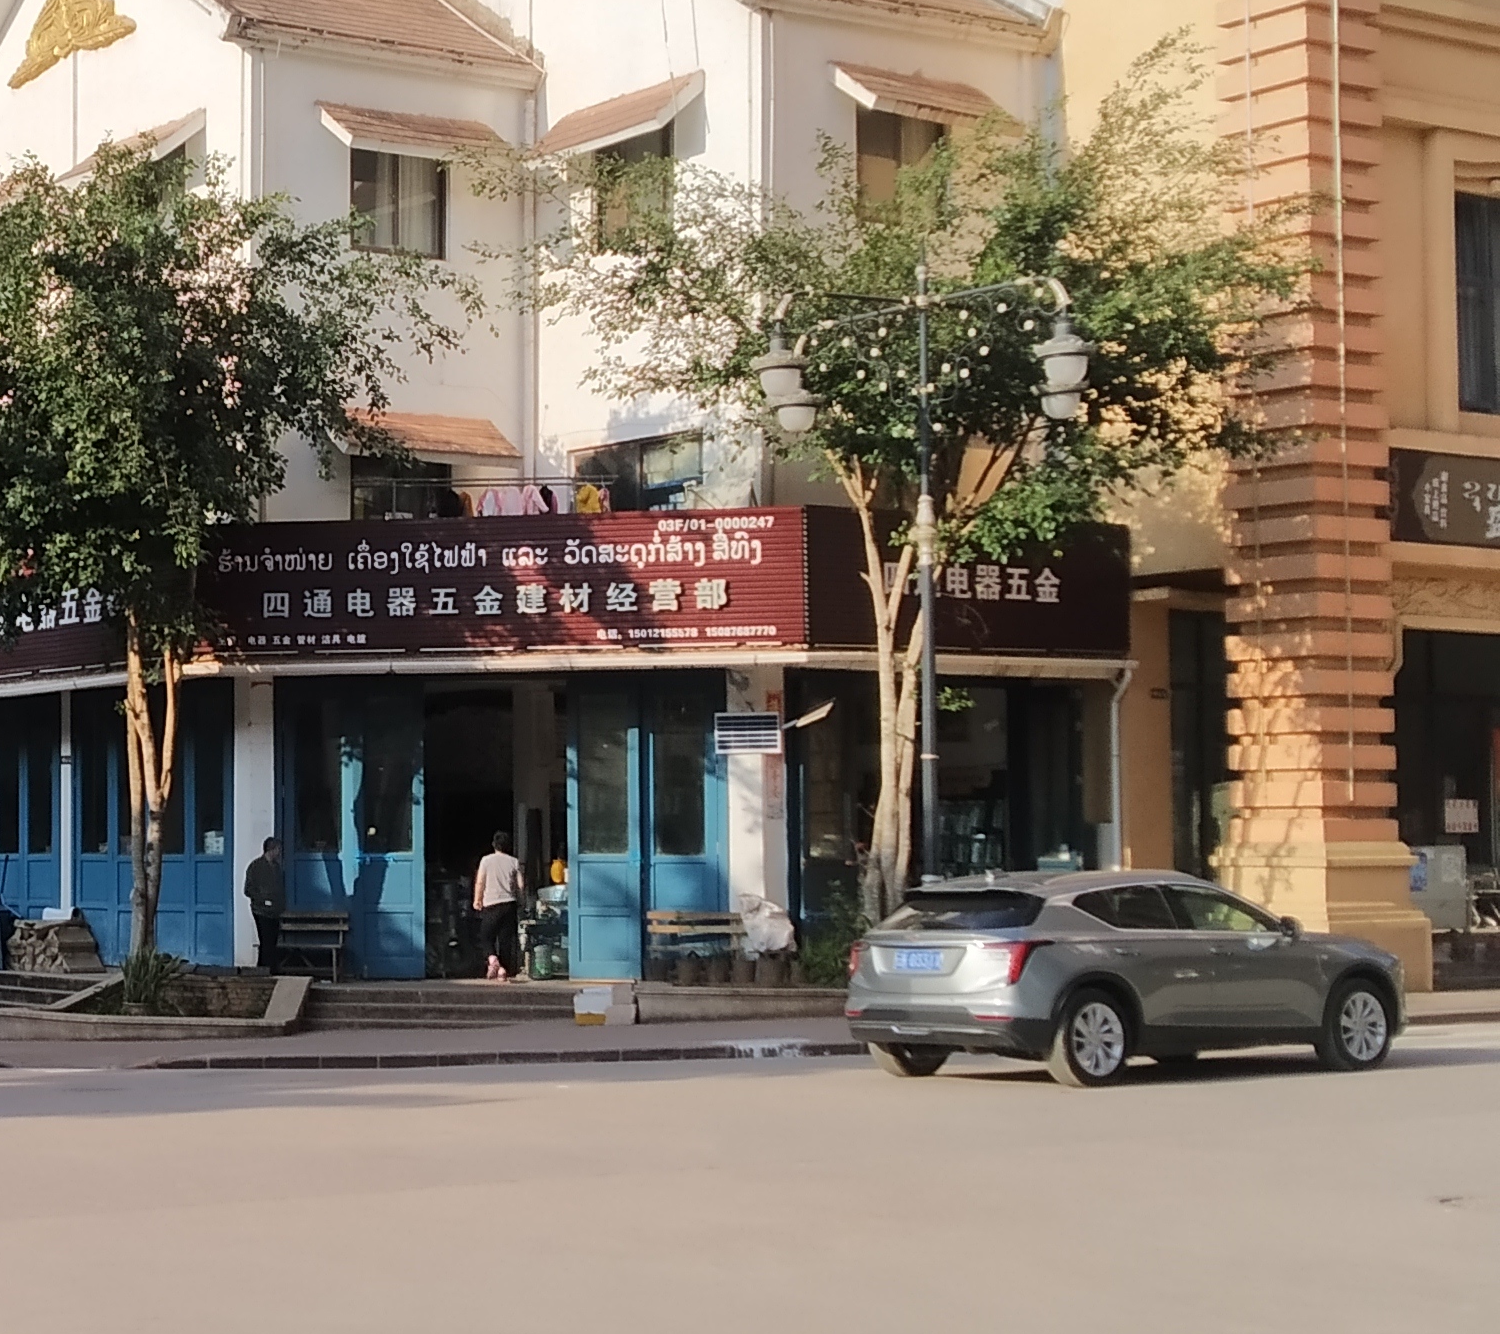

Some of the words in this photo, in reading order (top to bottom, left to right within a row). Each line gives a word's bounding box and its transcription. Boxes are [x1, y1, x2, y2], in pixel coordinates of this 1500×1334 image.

[657, 516, 775, 533] 03F/01-0000247
[502, 546, 548, 567] ແລະ
[883, 562, 1061, 603] 四电器五金
[262, 578, 729, 618] 四通电器五金建材经营部
[272, 635, 292, 645] 五金
